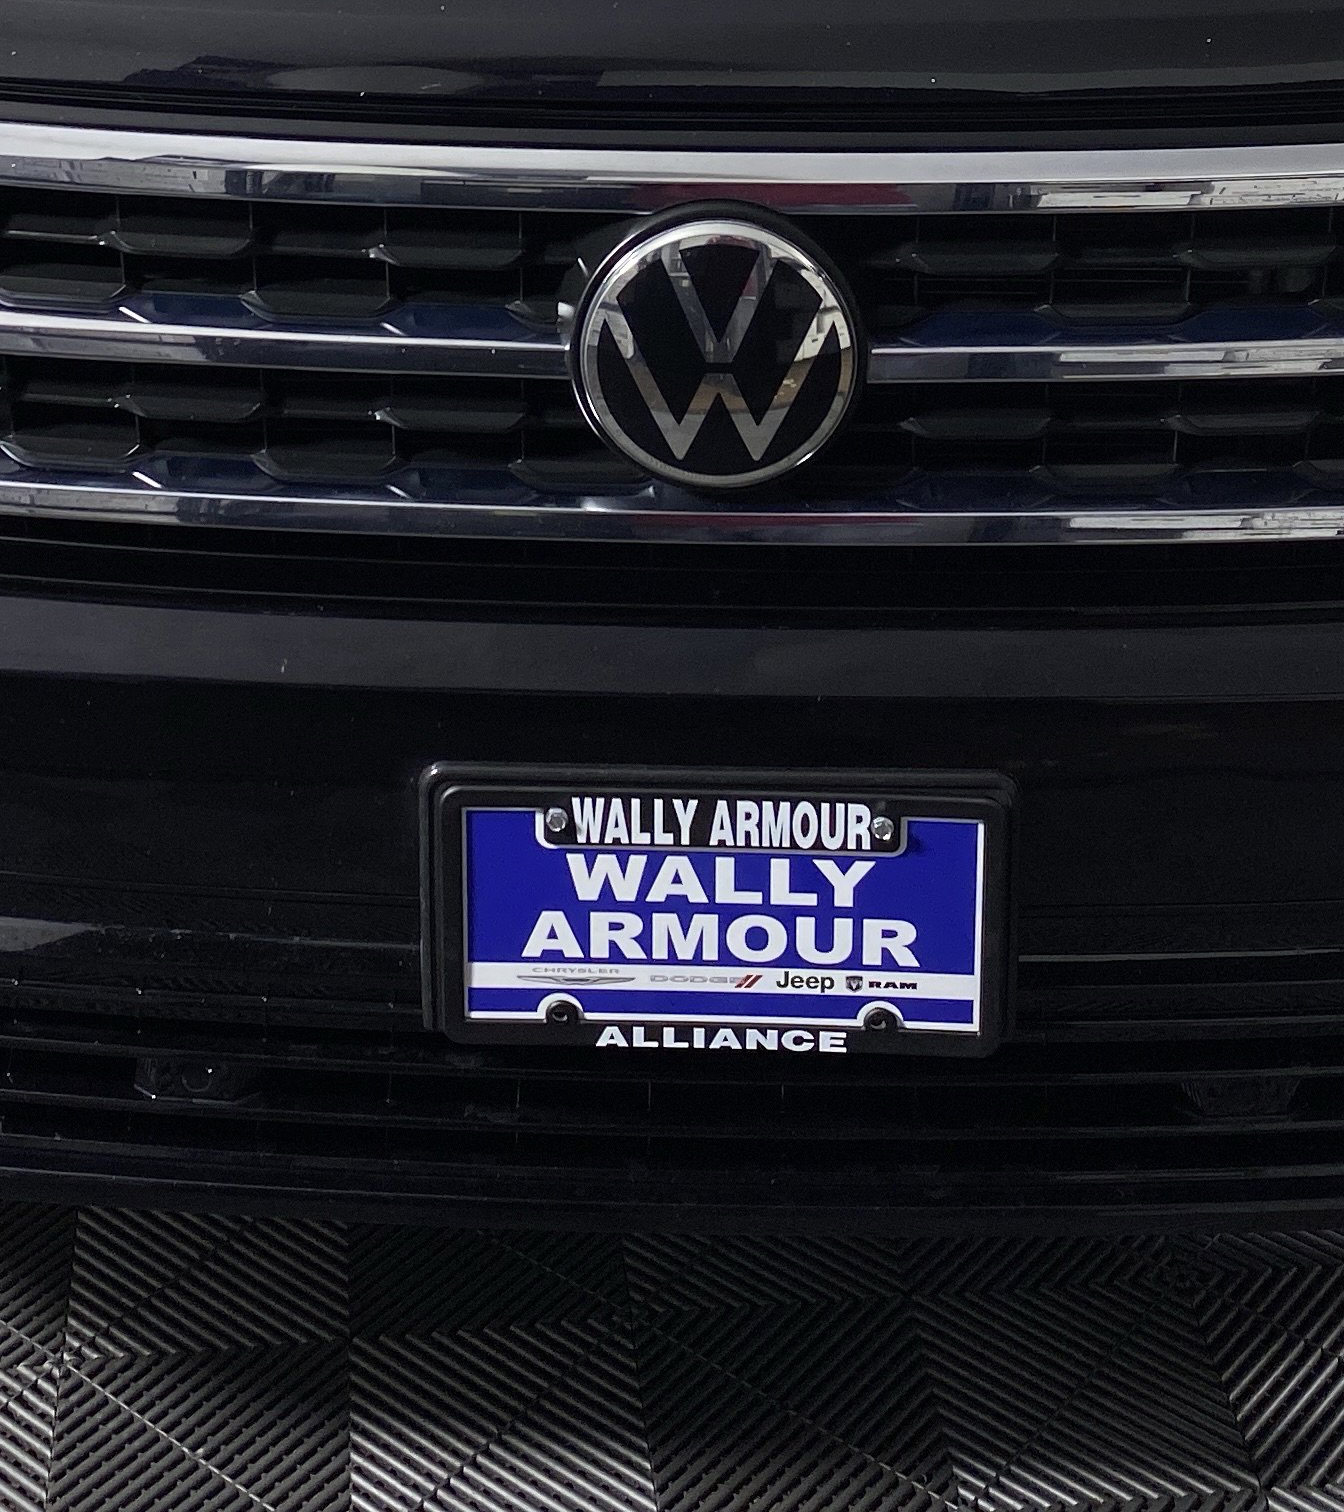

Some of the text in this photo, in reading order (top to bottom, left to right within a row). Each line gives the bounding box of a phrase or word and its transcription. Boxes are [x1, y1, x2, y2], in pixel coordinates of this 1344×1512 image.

[570, 796, 872, 851] WALLY ARMOUR
[565, 852, 876, 908] WALLY
[521, 910, 921, 968] ARMOUR
[531, 966, 620, 975] CHRYSLER
[775, 970, 835, 994] Jeep
[868, 980, 918, 990] RAM
[595, 1025, 848, 1053] ALLIANCE
